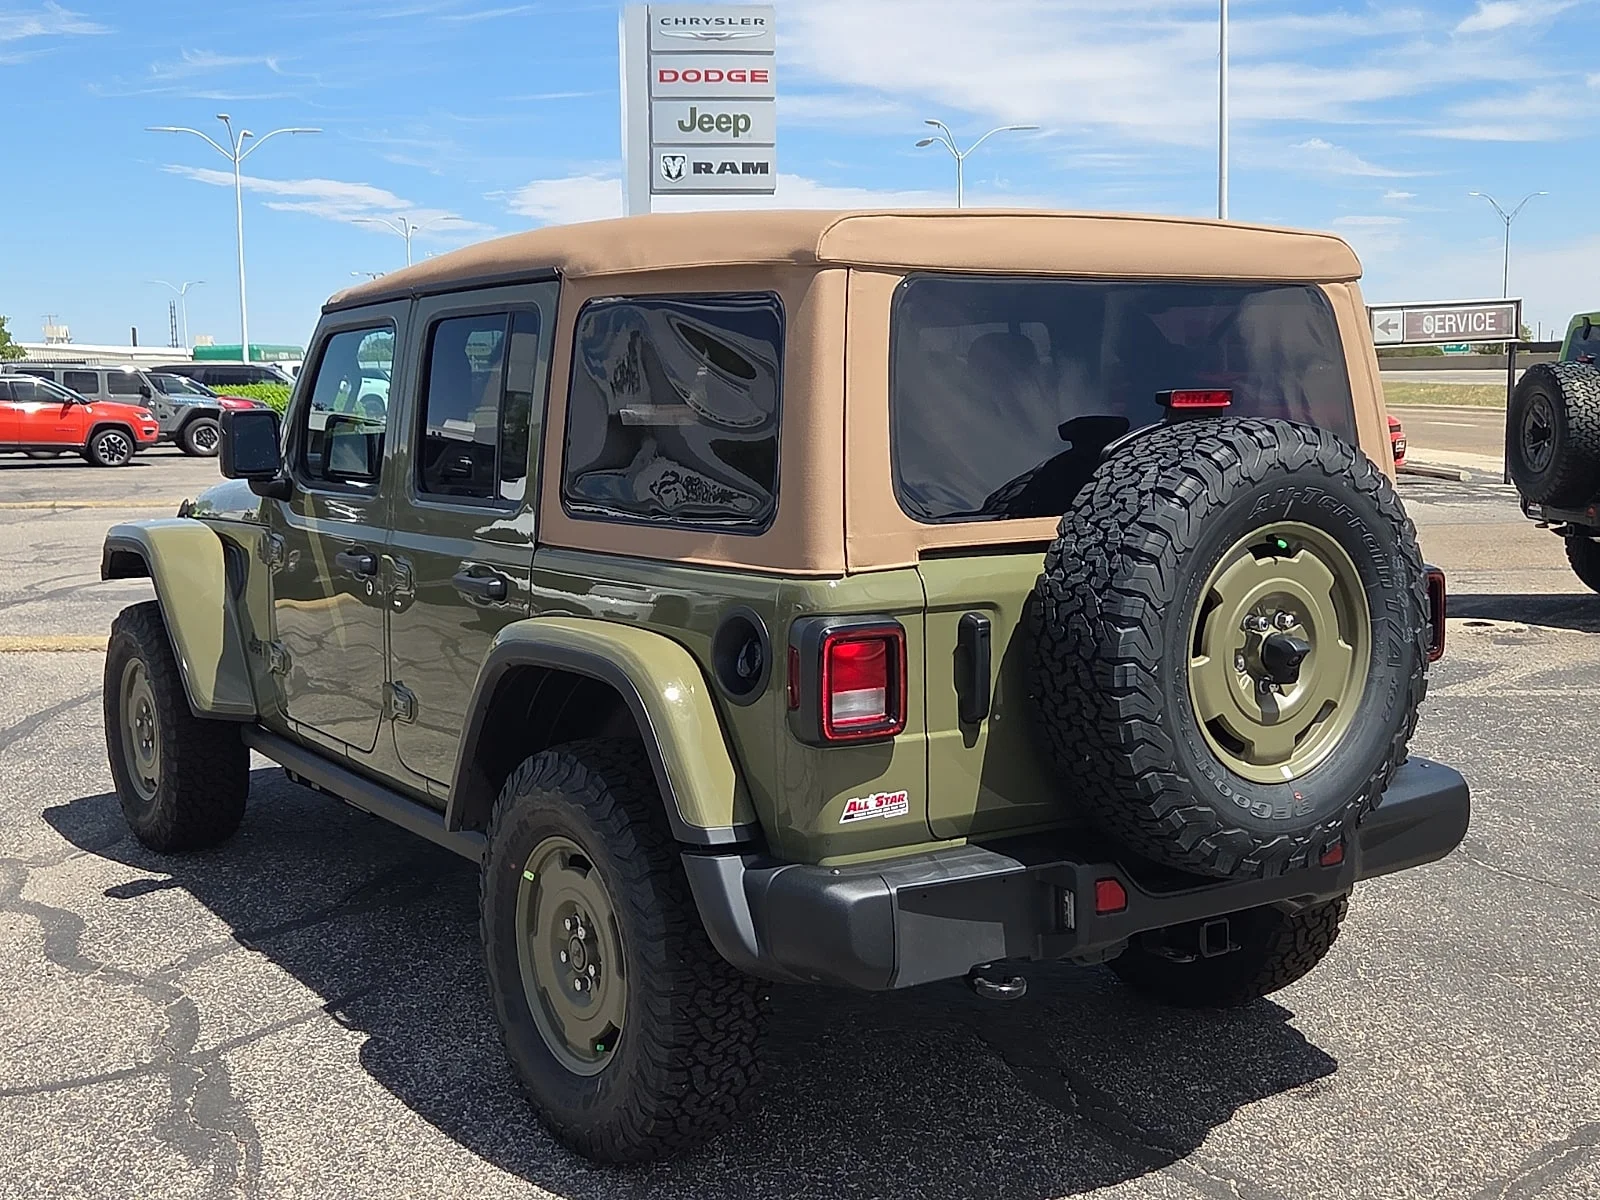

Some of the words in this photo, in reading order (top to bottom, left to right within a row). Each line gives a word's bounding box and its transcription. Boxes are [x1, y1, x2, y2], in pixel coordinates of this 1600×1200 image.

[660, 17, 766, 26] CHRYSLER
[659, 70, 769, 83] DODGE
[677, 106, 751, 138] Jeep
[692, 162, 769, 175] RAM
[1422, 311, 1497, 334] SERVICE
